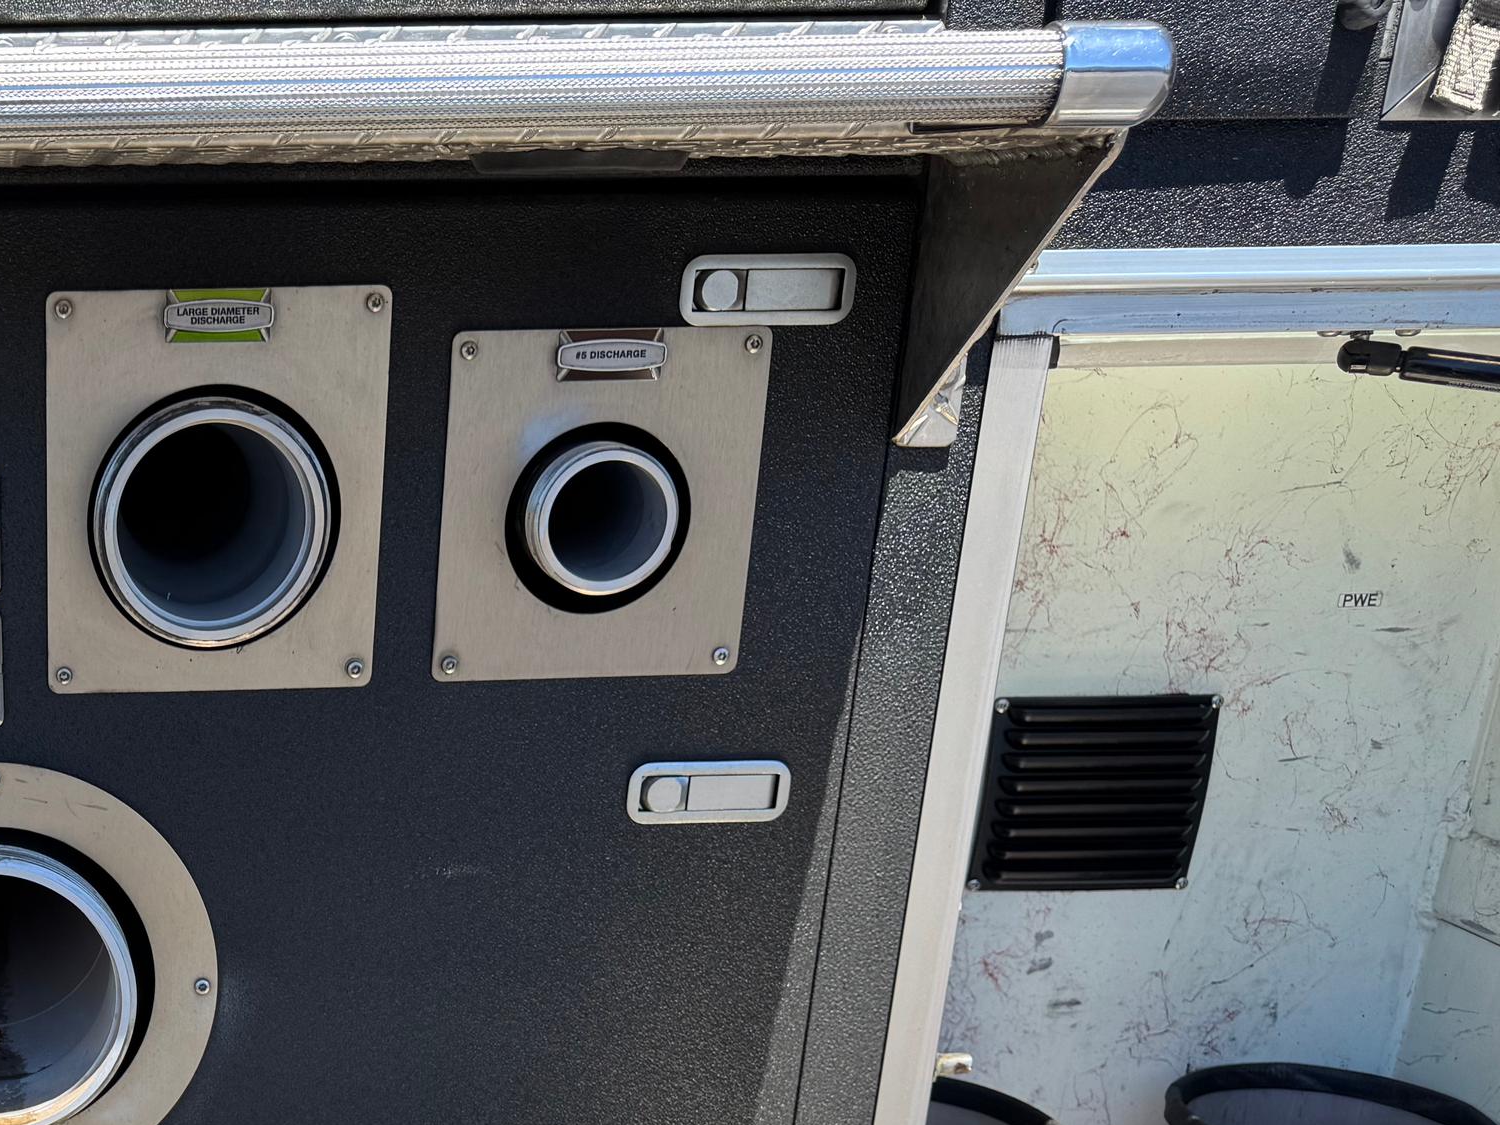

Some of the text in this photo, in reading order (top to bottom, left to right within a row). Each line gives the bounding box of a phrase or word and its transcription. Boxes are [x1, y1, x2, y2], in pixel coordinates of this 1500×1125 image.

[177, 307, 260, 316] LARGE DIAMETER
[191, 316, 245, 325] DISCHARGE
[576, 350, 647, 360] #5 DISCHARGE
[1342, 592, 1378, 608] PWE
